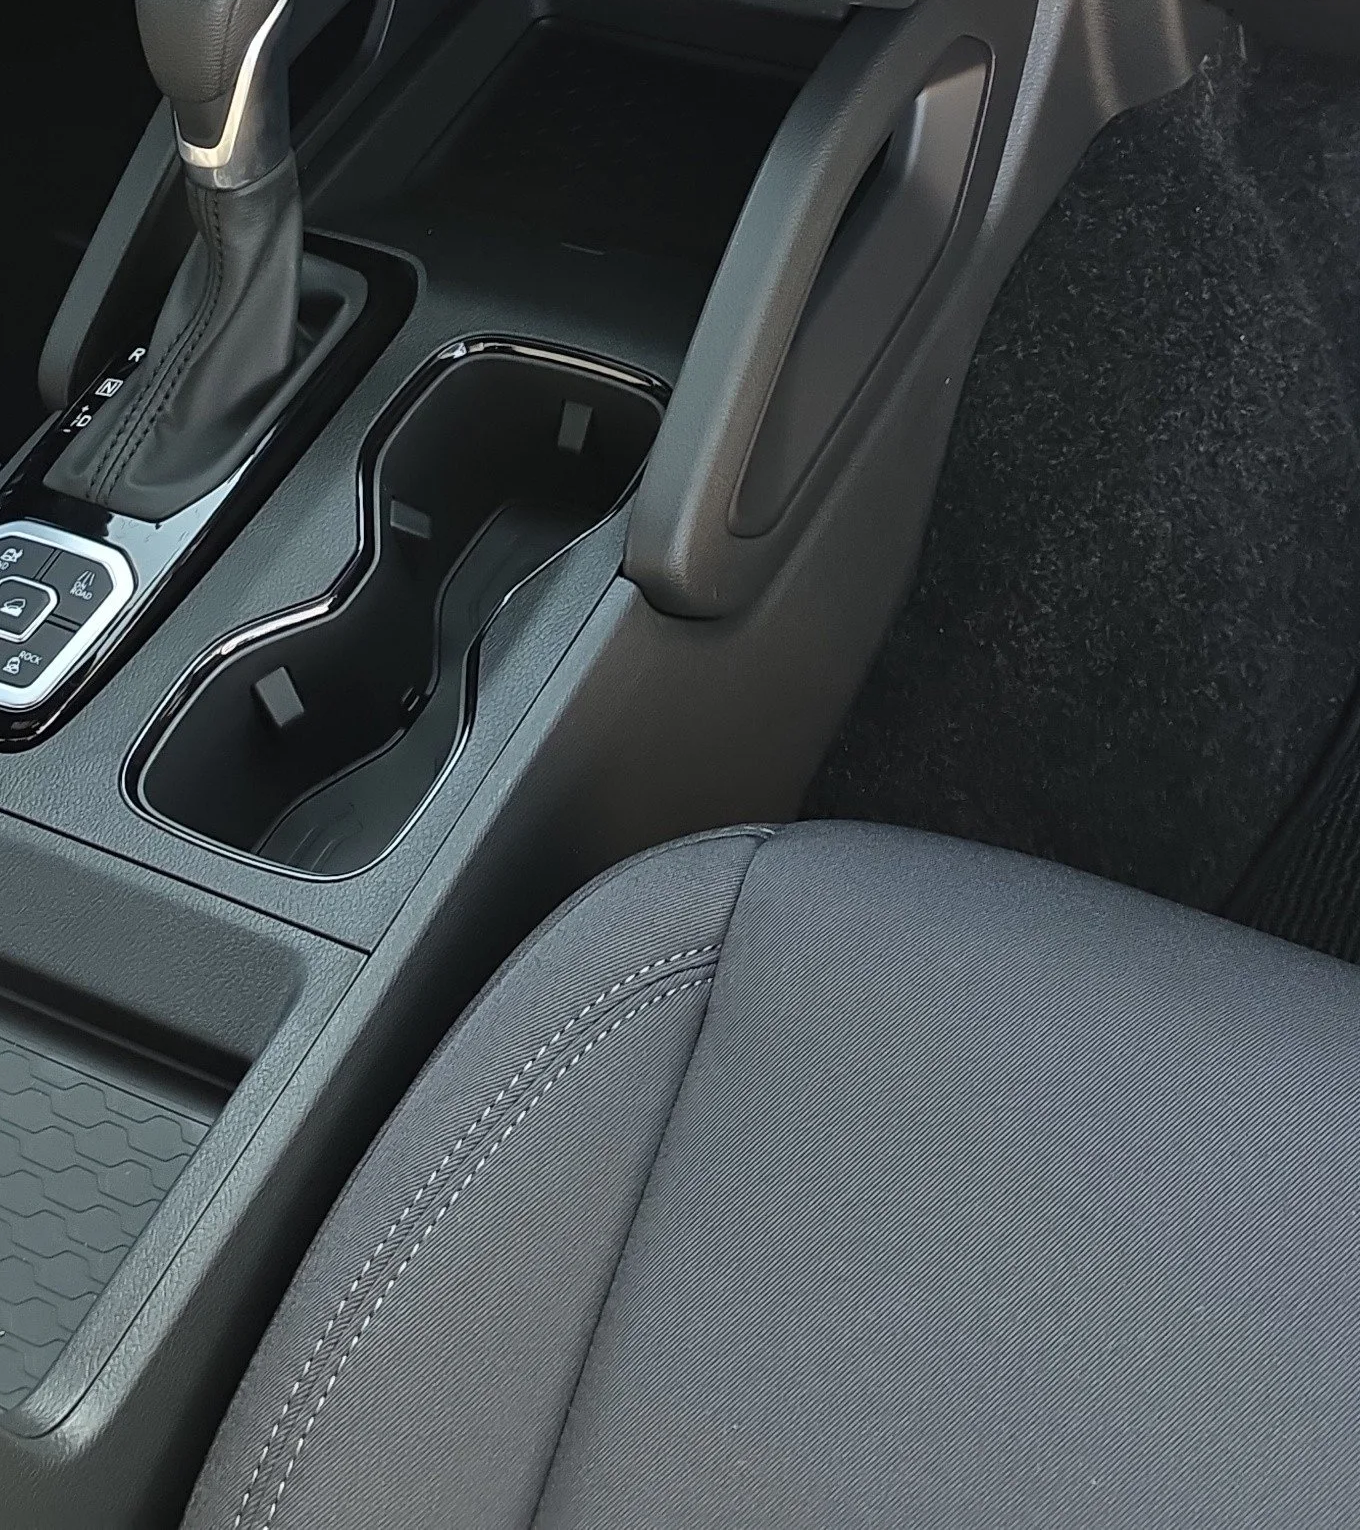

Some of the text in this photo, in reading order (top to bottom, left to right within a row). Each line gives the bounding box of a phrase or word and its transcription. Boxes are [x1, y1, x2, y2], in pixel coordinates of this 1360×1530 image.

[127, 347, 146, 363] R
[69, 588, 93, 601] ROAD
[18, 650, 43, 665] ROCK
